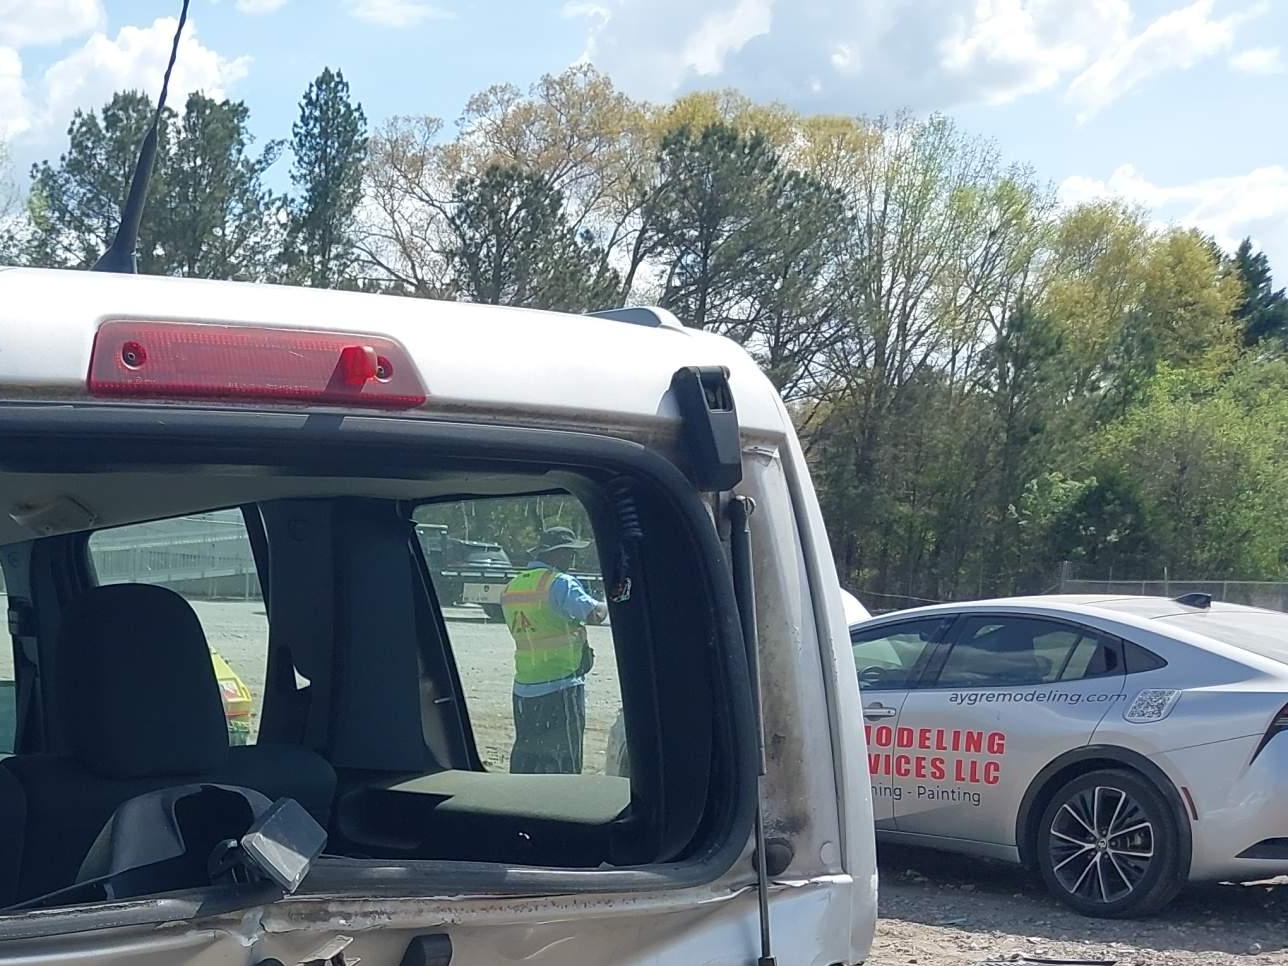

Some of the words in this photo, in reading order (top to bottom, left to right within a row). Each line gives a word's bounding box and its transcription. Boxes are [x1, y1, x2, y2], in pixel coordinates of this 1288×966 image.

[949, 690, 1128, 706] aygremodeling.com
[954, 759, 1000, 785] LLC
[917, 785, 981, 806] Painting
